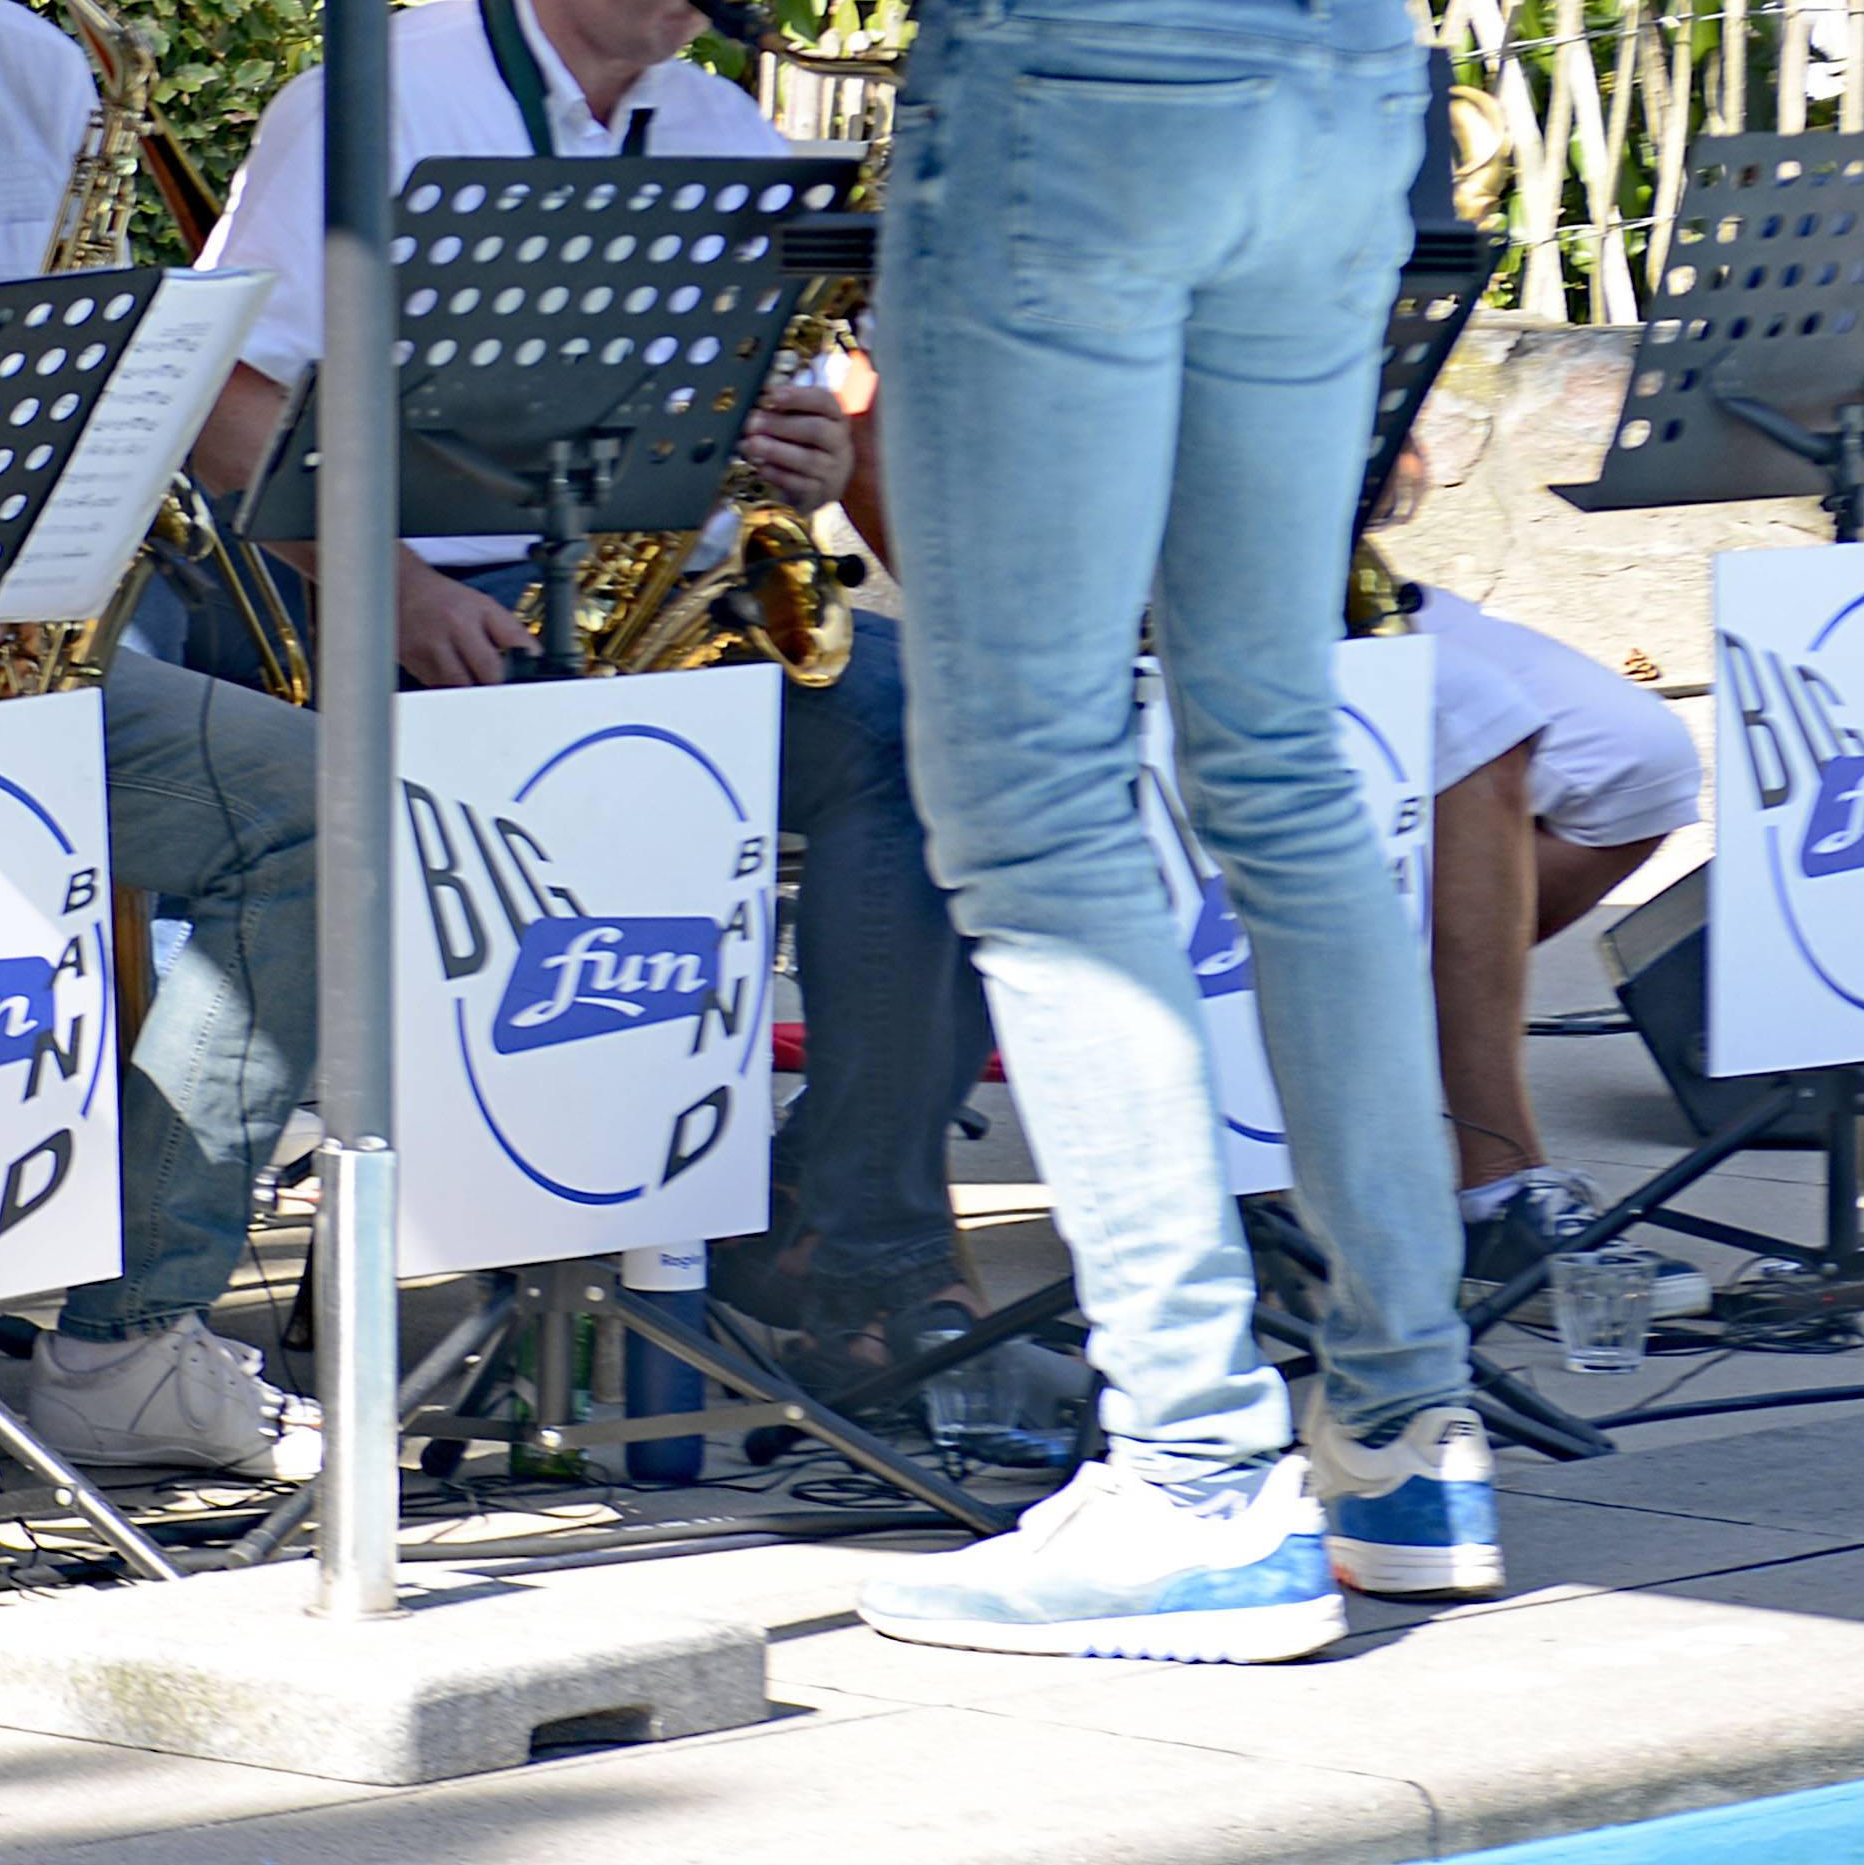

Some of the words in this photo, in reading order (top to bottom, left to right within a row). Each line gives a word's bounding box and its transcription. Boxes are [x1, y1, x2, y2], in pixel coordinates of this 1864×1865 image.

[402, 777, 588, 981] BIG
[508, 925, 709, 1028] fun
[657, 835, 768, 1191] BAND
